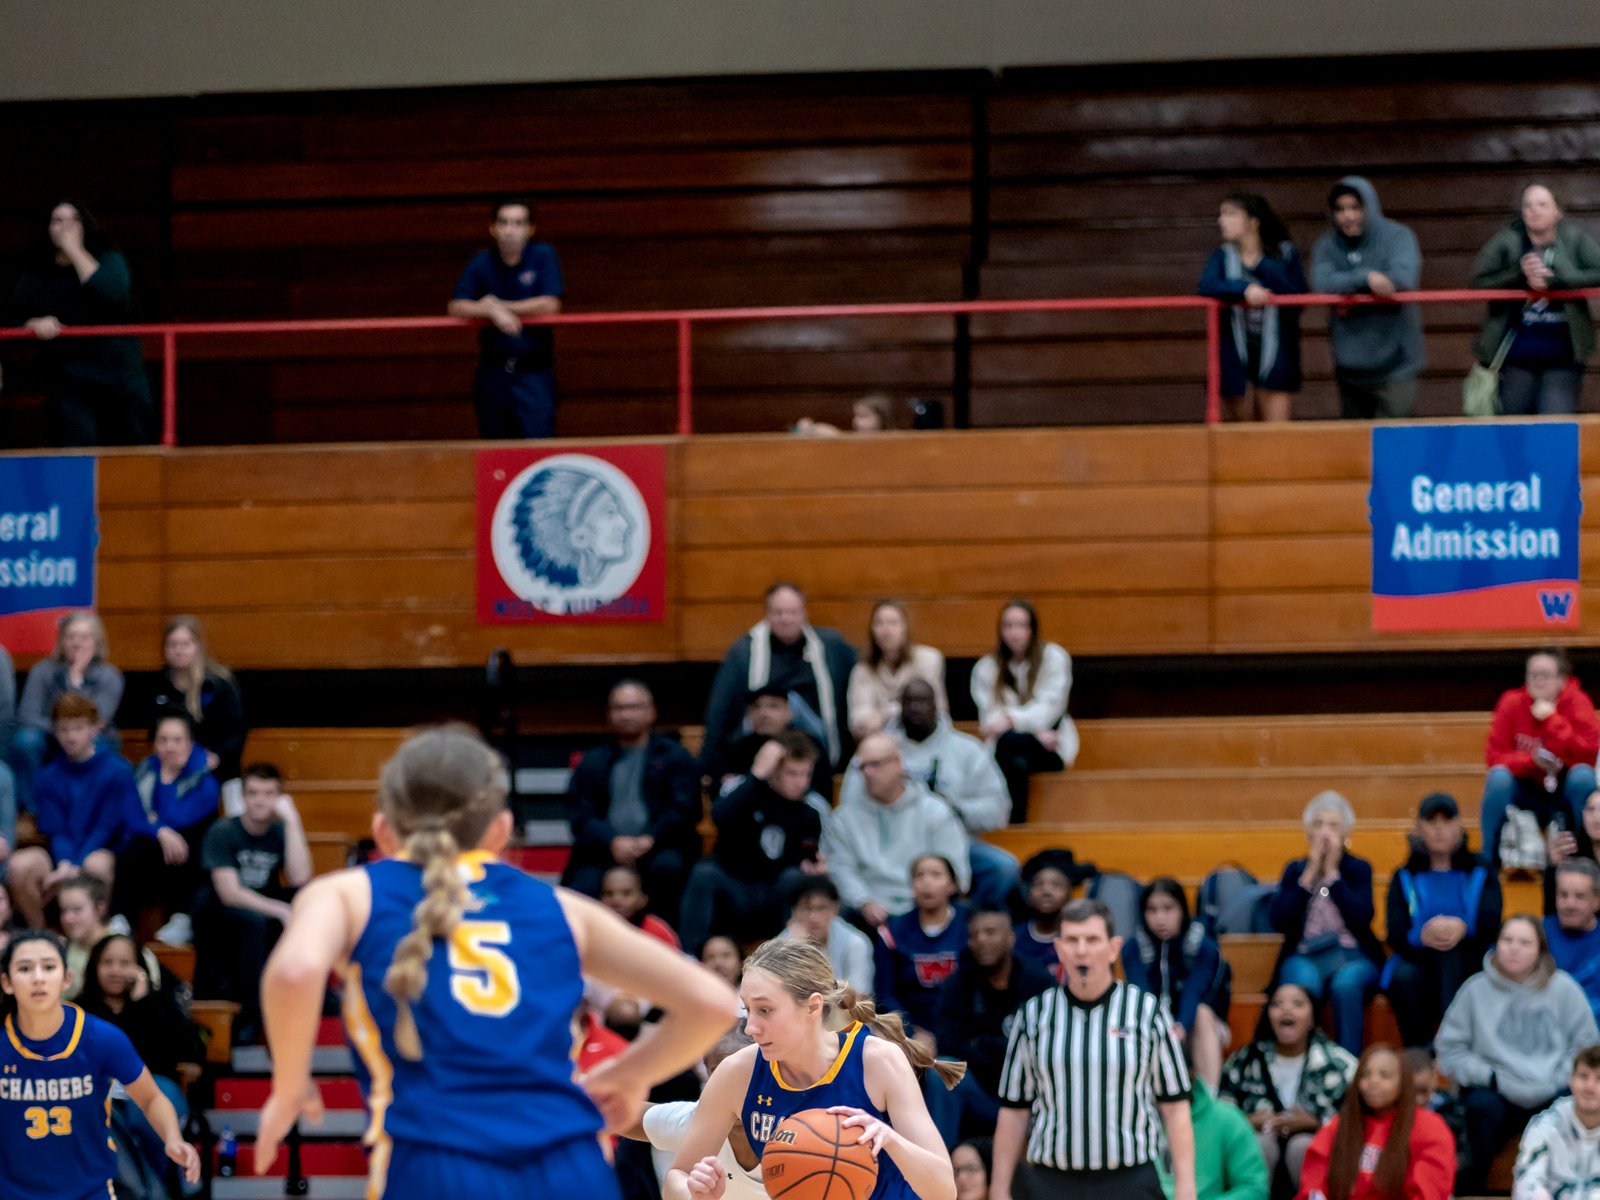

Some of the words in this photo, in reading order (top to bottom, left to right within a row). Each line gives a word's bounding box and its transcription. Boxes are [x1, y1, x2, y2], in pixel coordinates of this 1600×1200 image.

[1411, 473, 1541, 513] General
[0, 505, 59, 541] eral
[1391, 521, 1560, 561] Admission
[1538, 590, 1573, 622] W
[447, 920, 522, 1018] 5
[0, 1075, 93, 1101] CHARGERS
[24, 1106, 72, 1139] 33
